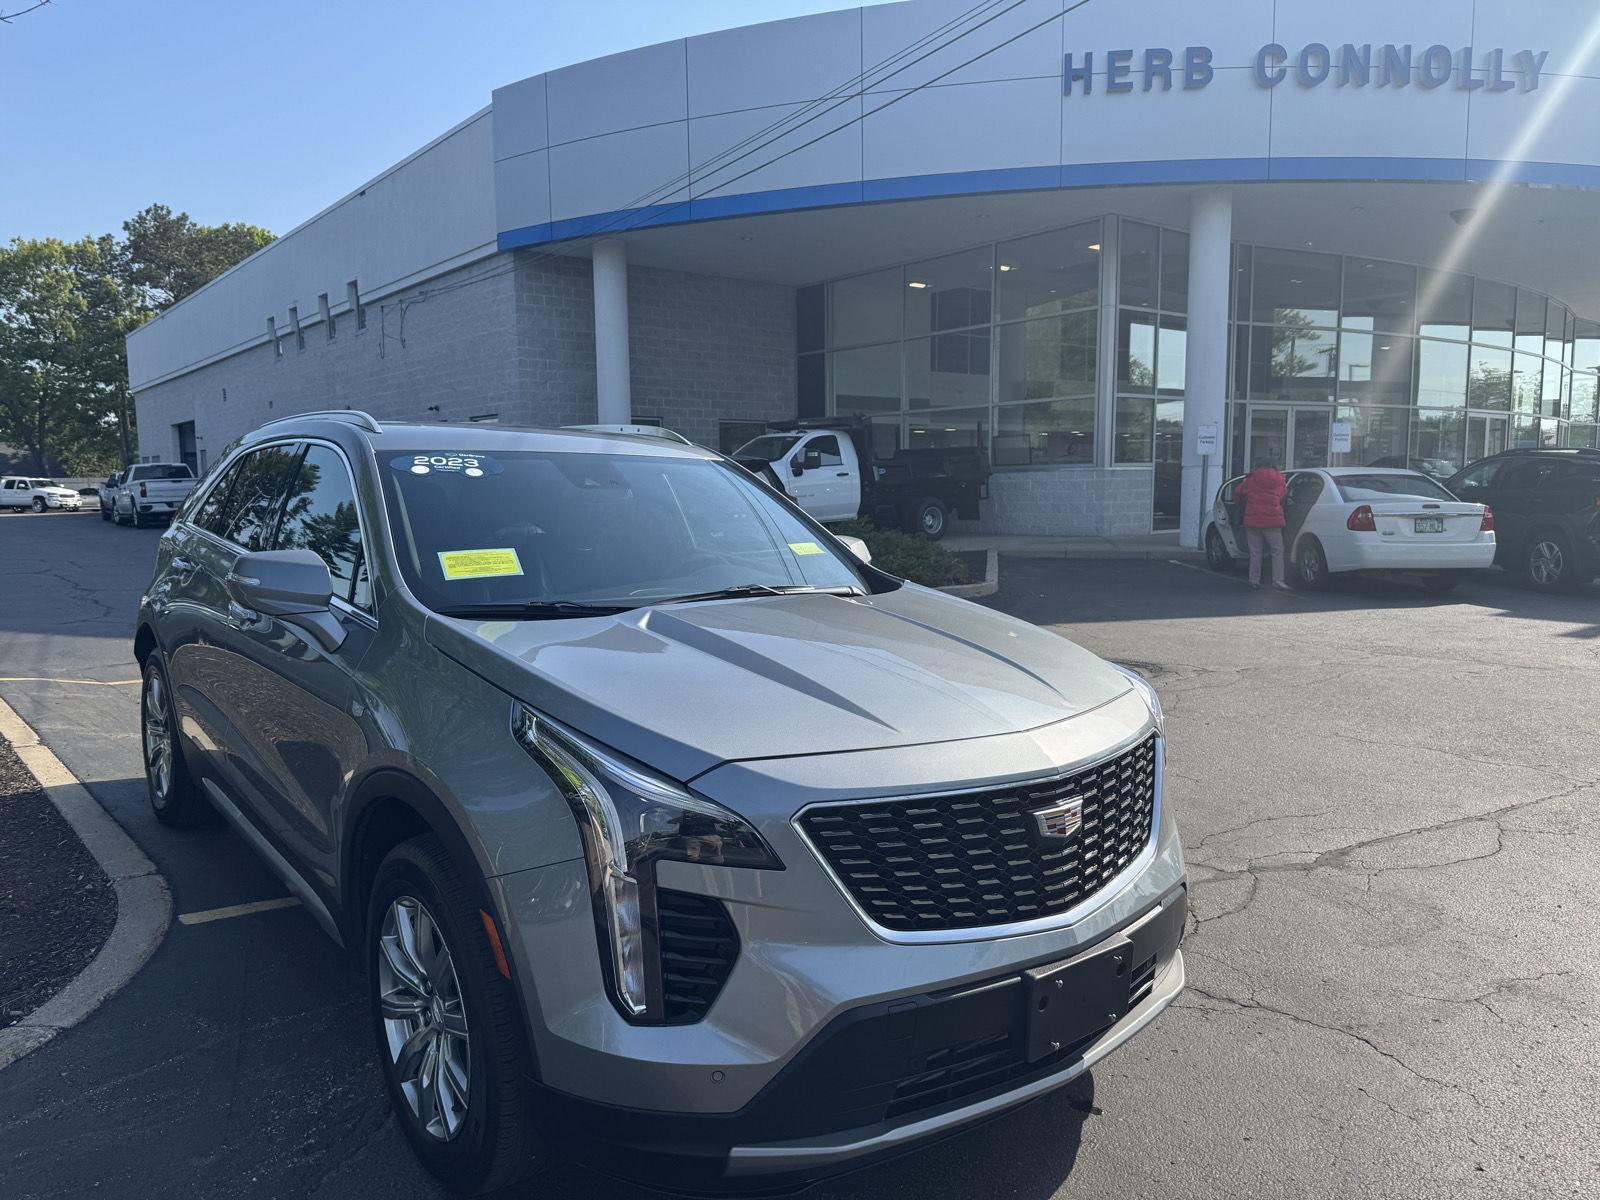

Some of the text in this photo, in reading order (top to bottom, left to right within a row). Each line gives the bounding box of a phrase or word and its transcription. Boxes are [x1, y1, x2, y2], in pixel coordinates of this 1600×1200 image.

[1063, 42, 1549, 96] HERB CONNOLLY
[414, 456, 479, 467] 2023
